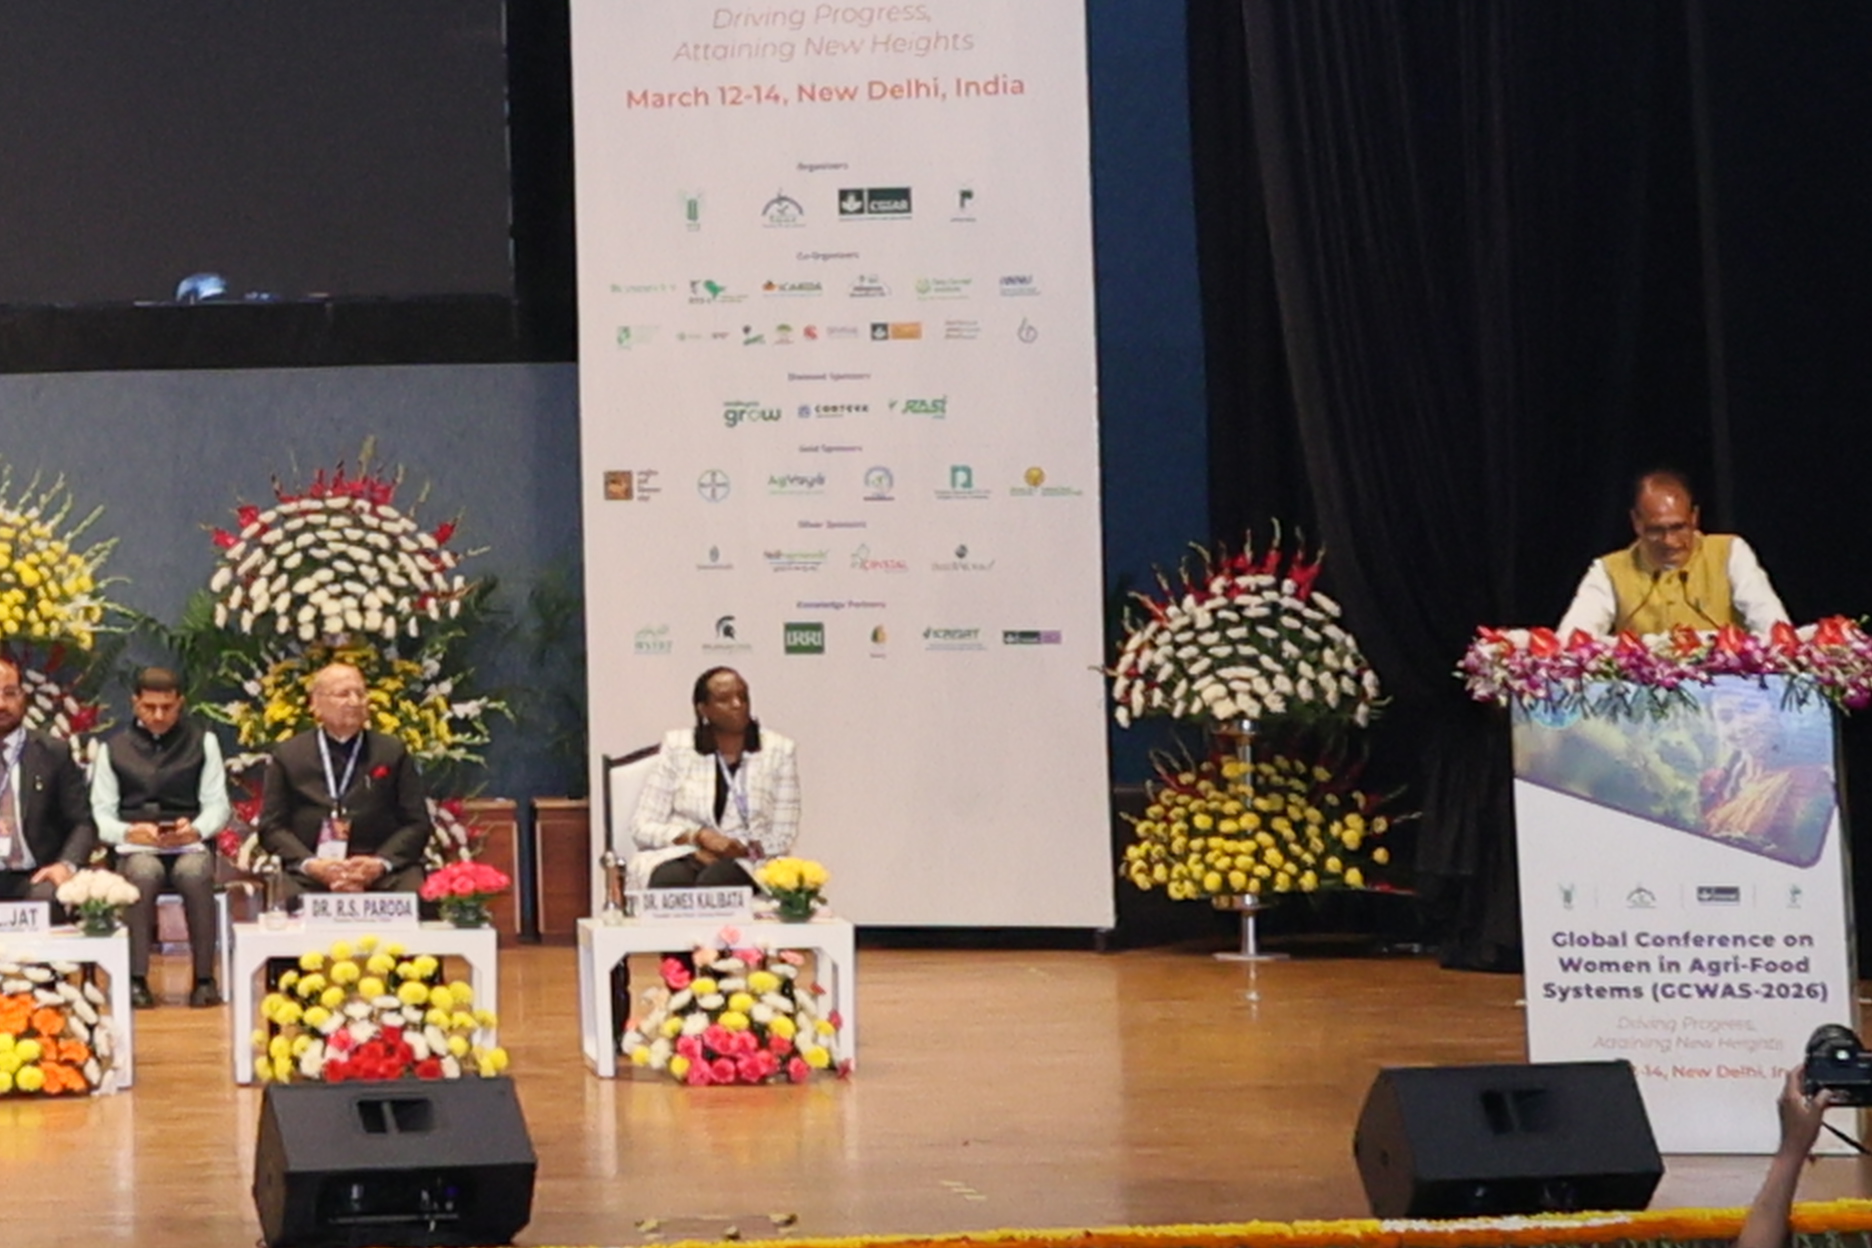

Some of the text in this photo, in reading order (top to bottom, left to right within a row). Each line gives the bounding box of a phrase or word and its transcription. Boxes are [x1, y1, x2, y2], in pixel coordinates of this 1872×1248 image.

[712, 4, 932, 31] Driving Progress,
[672, 30, 975, 62] Attaining New Heights
[627, 74, 1024, 109] March 12-14, New Delhi, India
[786, 630, 823, 645] IRRI
[364, 899, 412, 916] PARODA
[1552, 931, 1813, 947] Global Conference on
[1559, 955, 1810, 977] Women in Agri-Food
[1543, 982, 1828, 1002] Systems (GCWAS-2026)
[1672, 1065, 1711, 1078] New
